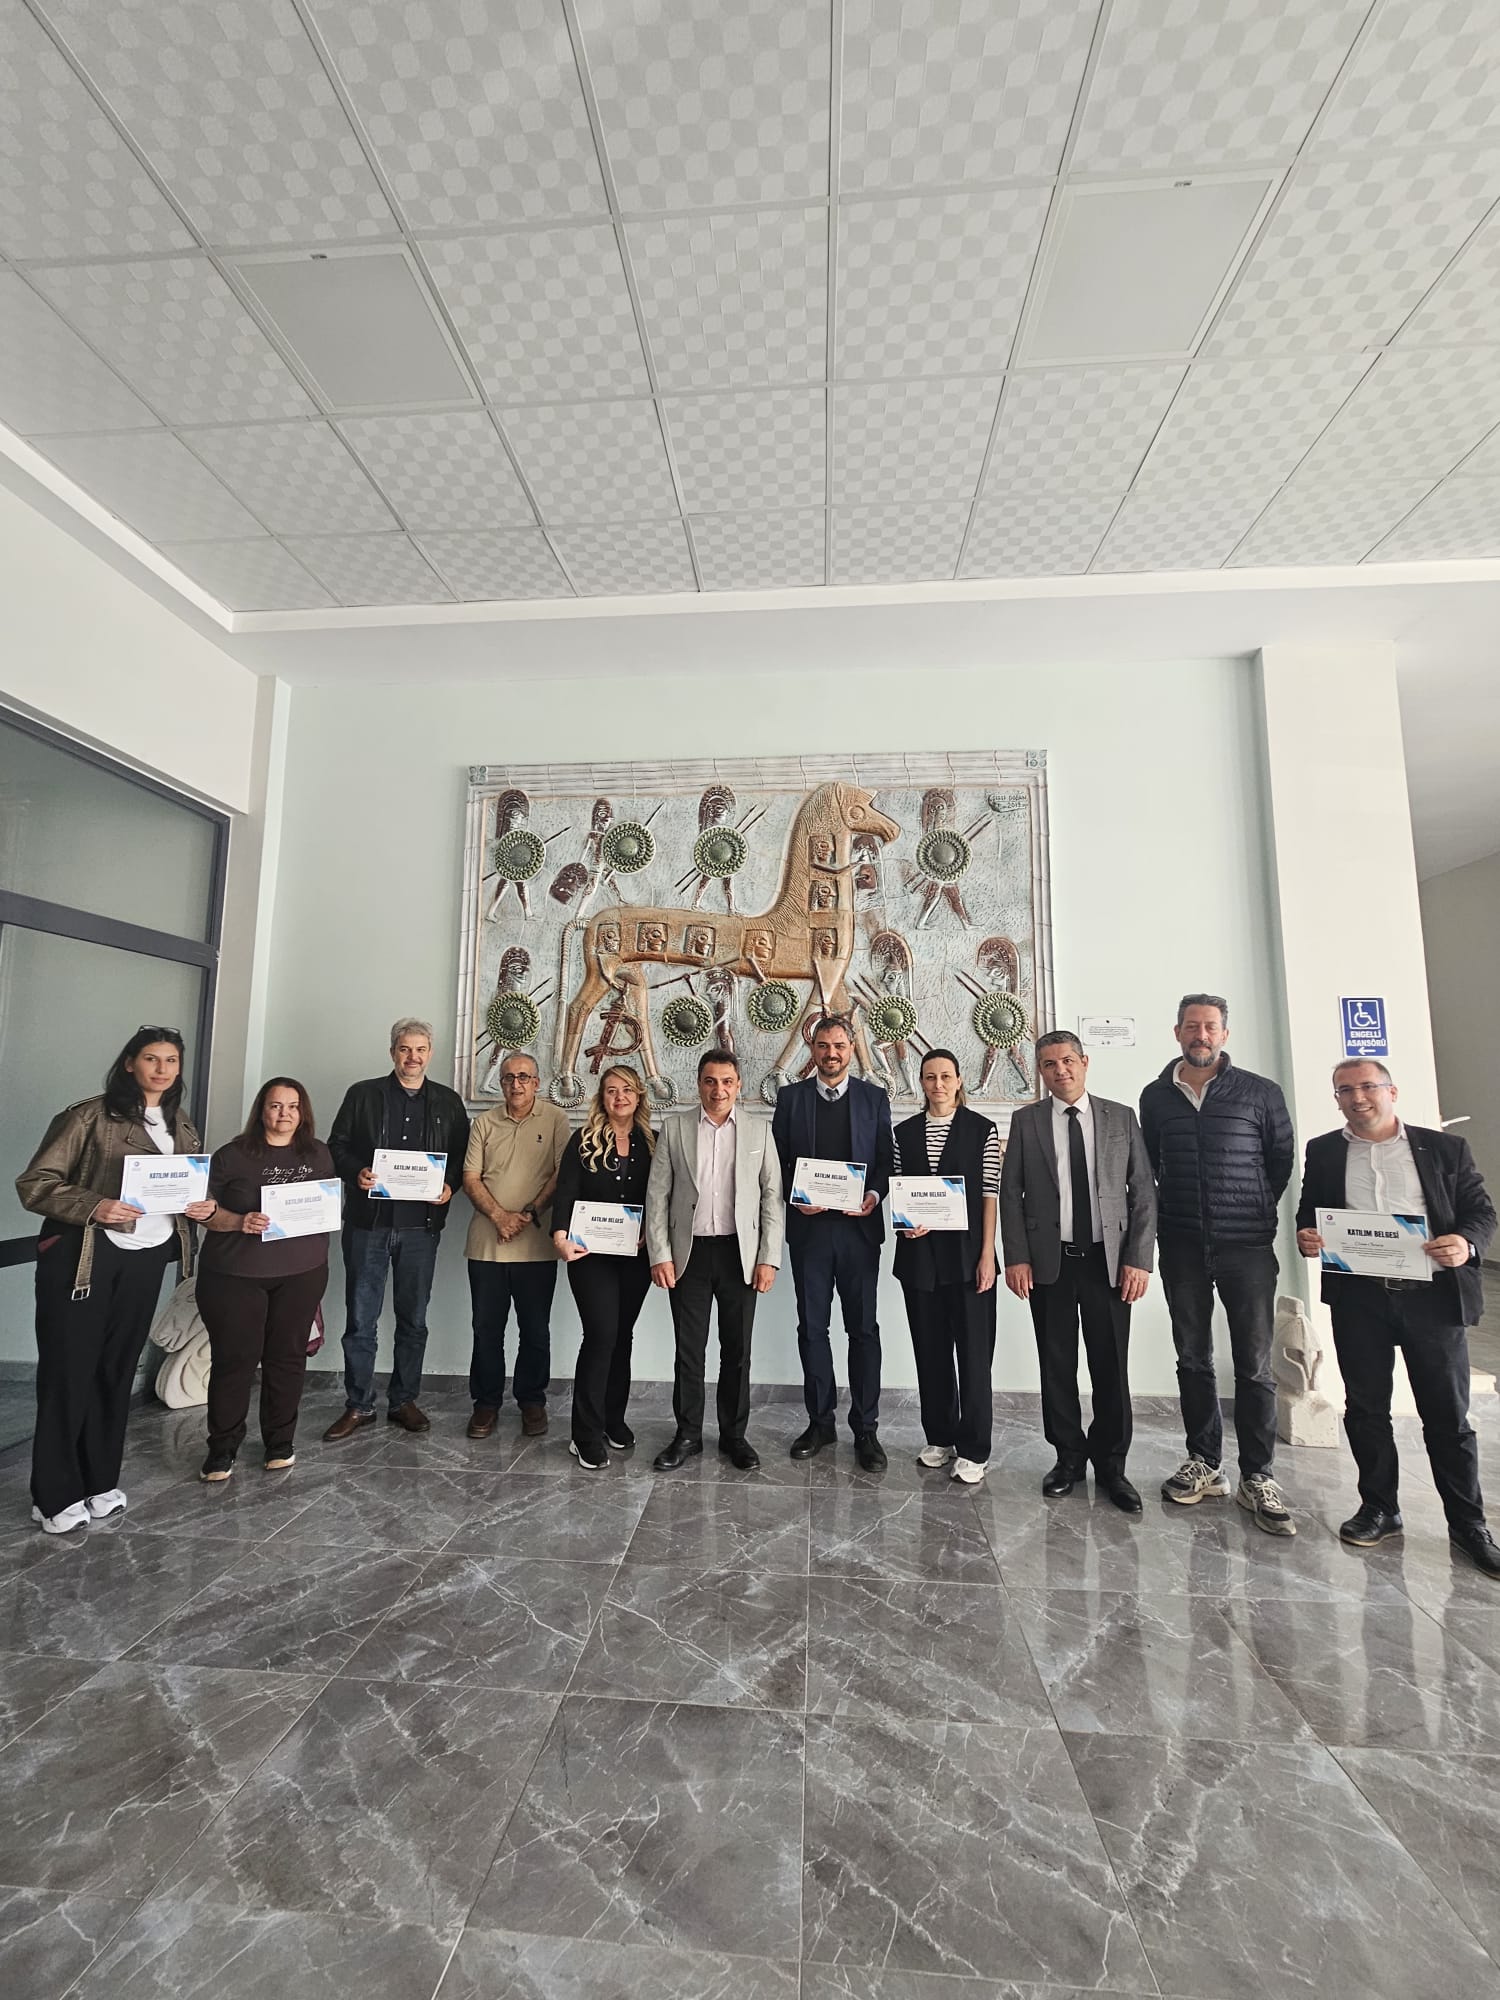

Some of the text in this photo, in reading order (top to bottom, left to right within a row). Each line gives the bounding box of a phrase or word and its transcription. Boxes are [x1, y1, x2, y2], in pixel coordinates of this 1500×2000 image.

[1350, 1029, 1382, 1039] ENGELLİ
[1347, 1038, 1387, 1047] ASANSÖRÜ
[1347, 1228, 1400, 1239] KATILIM BELGESİ
